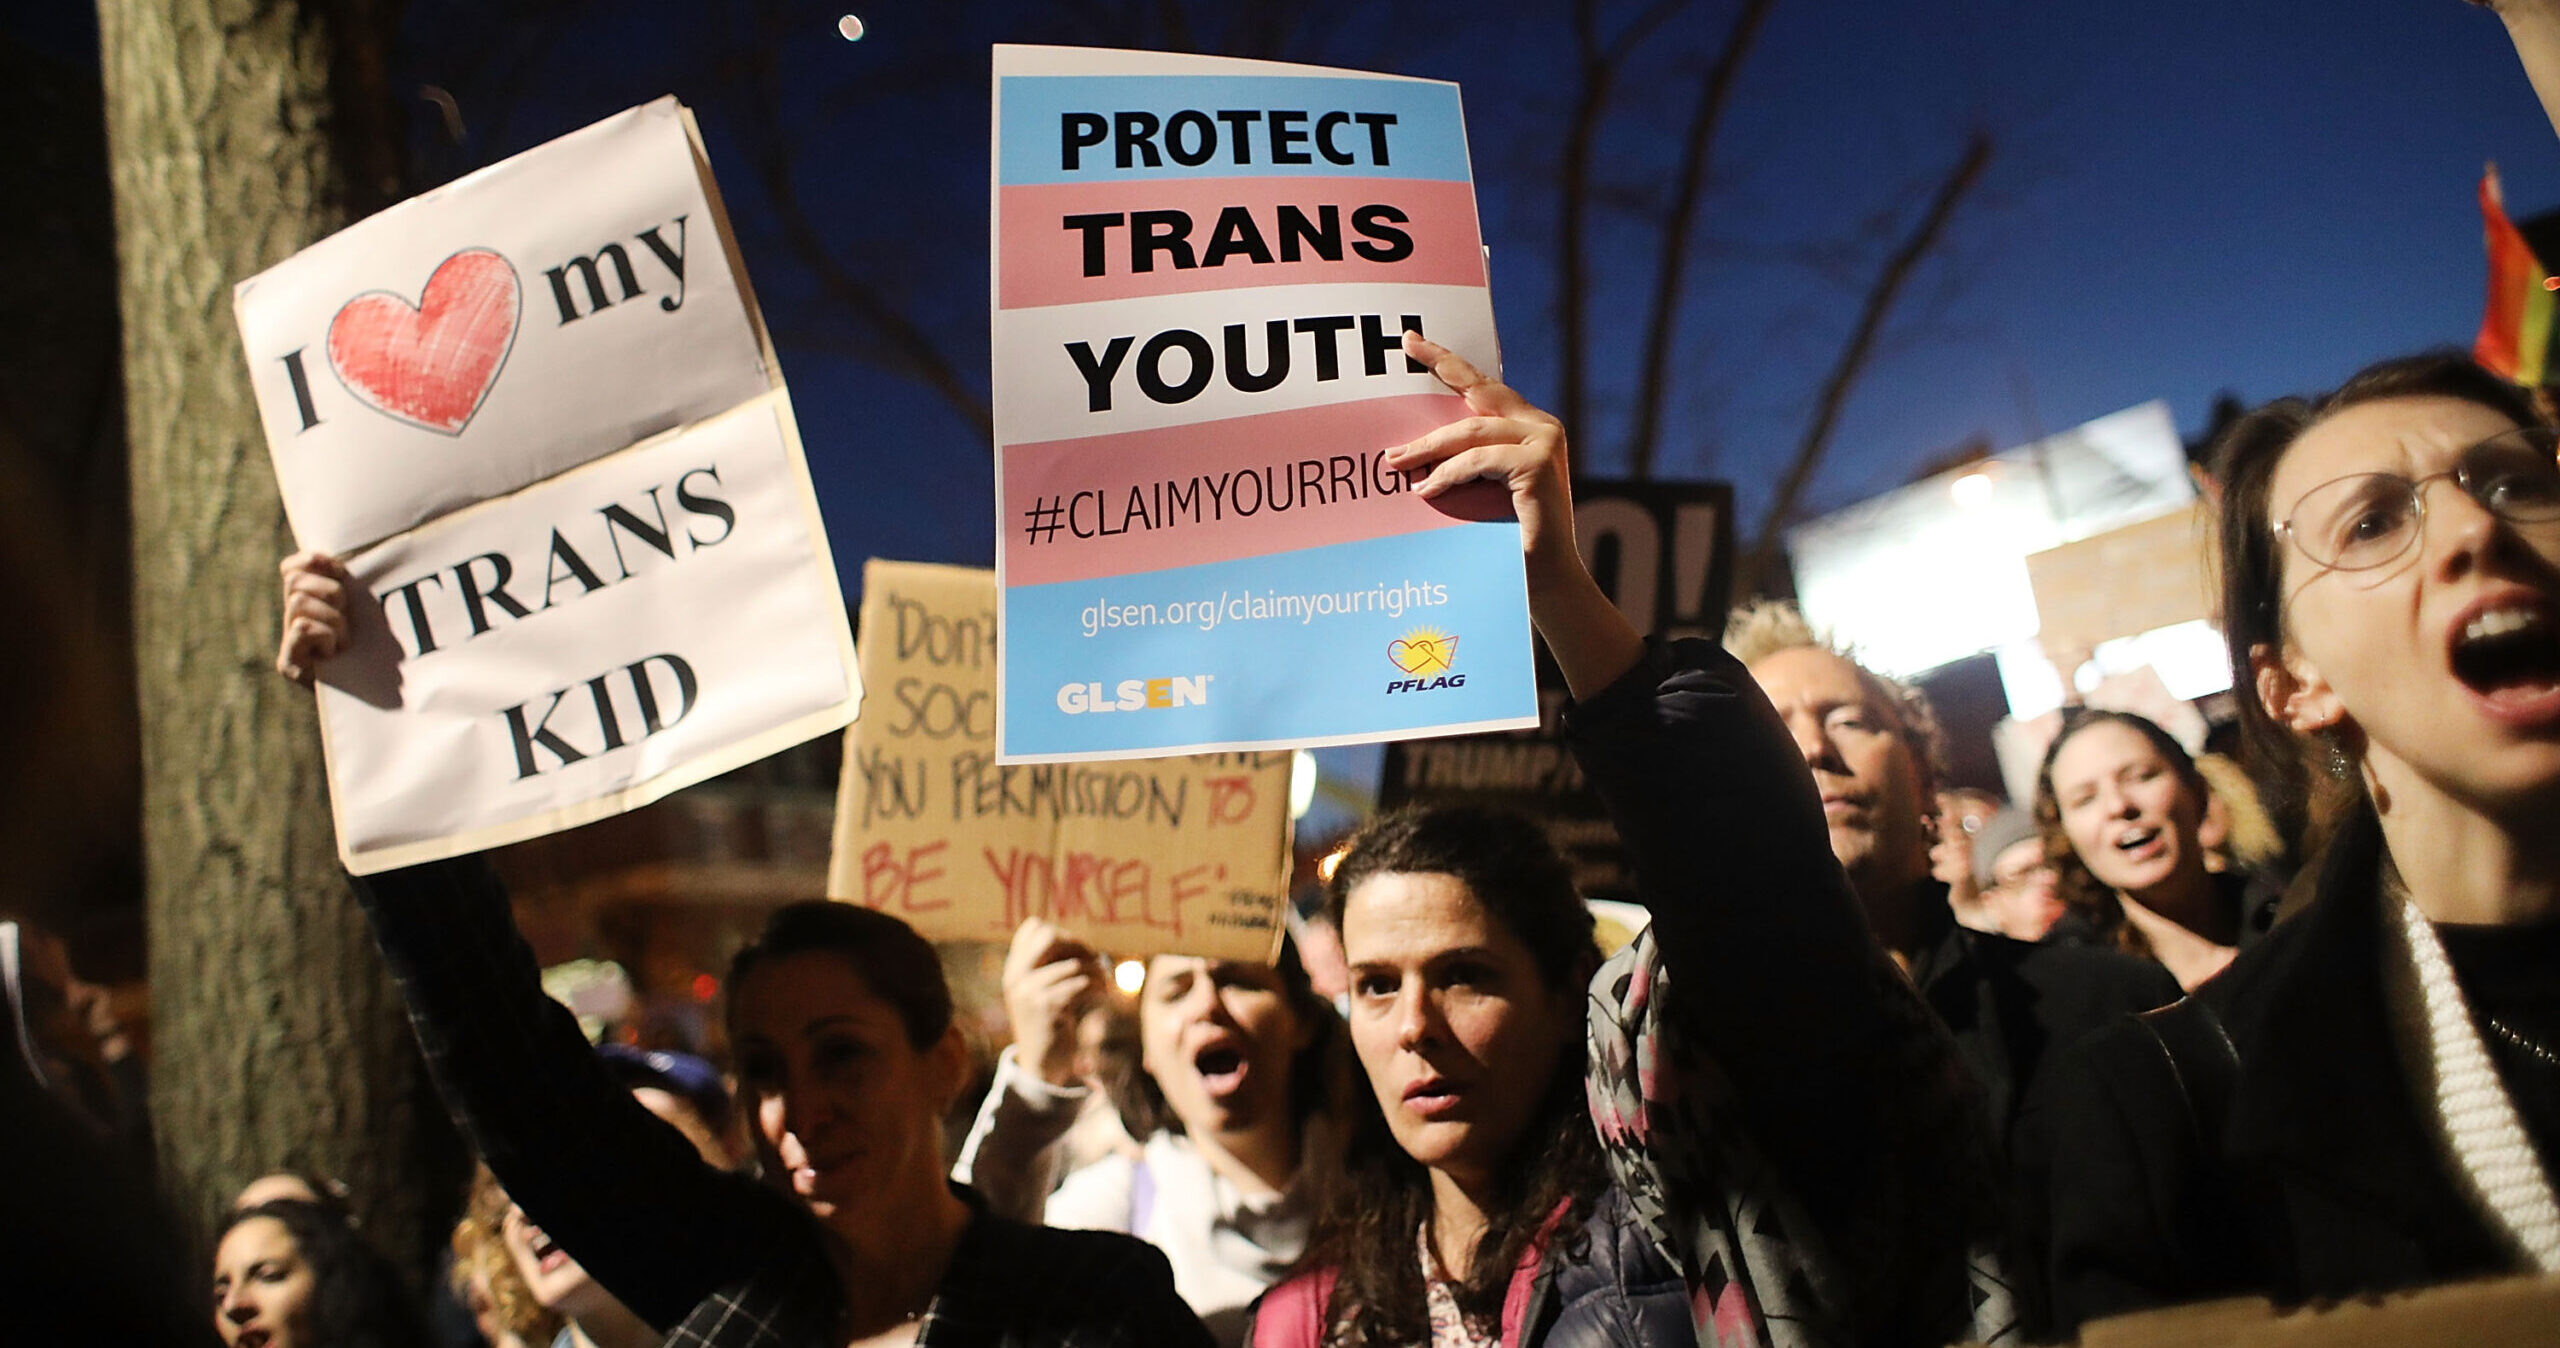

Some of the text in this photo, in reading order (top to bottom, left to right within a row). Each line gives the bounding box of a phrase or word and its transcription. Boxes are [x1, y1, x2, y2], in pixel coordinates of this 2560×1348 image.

[1060, 109, 1398, 171] PROTECT
[1062, 203, 1415, 278] TRANS
[276, 213, 691, 437] I my
[1063, 313, 1430, 413] YOUTH
[1024, 446, 1432, 546] #CLAIMYOURRIG
[378, 463, 738, 662] TRANS
[1081, 579, 1449, 637] glsen.org/claimyourrights
[495, 651, 702, 781] KID
[887, 677, 993, 741] SOC
[1386, 673, 1466, 696] PFLAG
[855, 748, 1257, 830] YOU PERMISSION TO
[861, 840, 952, 913] BE
